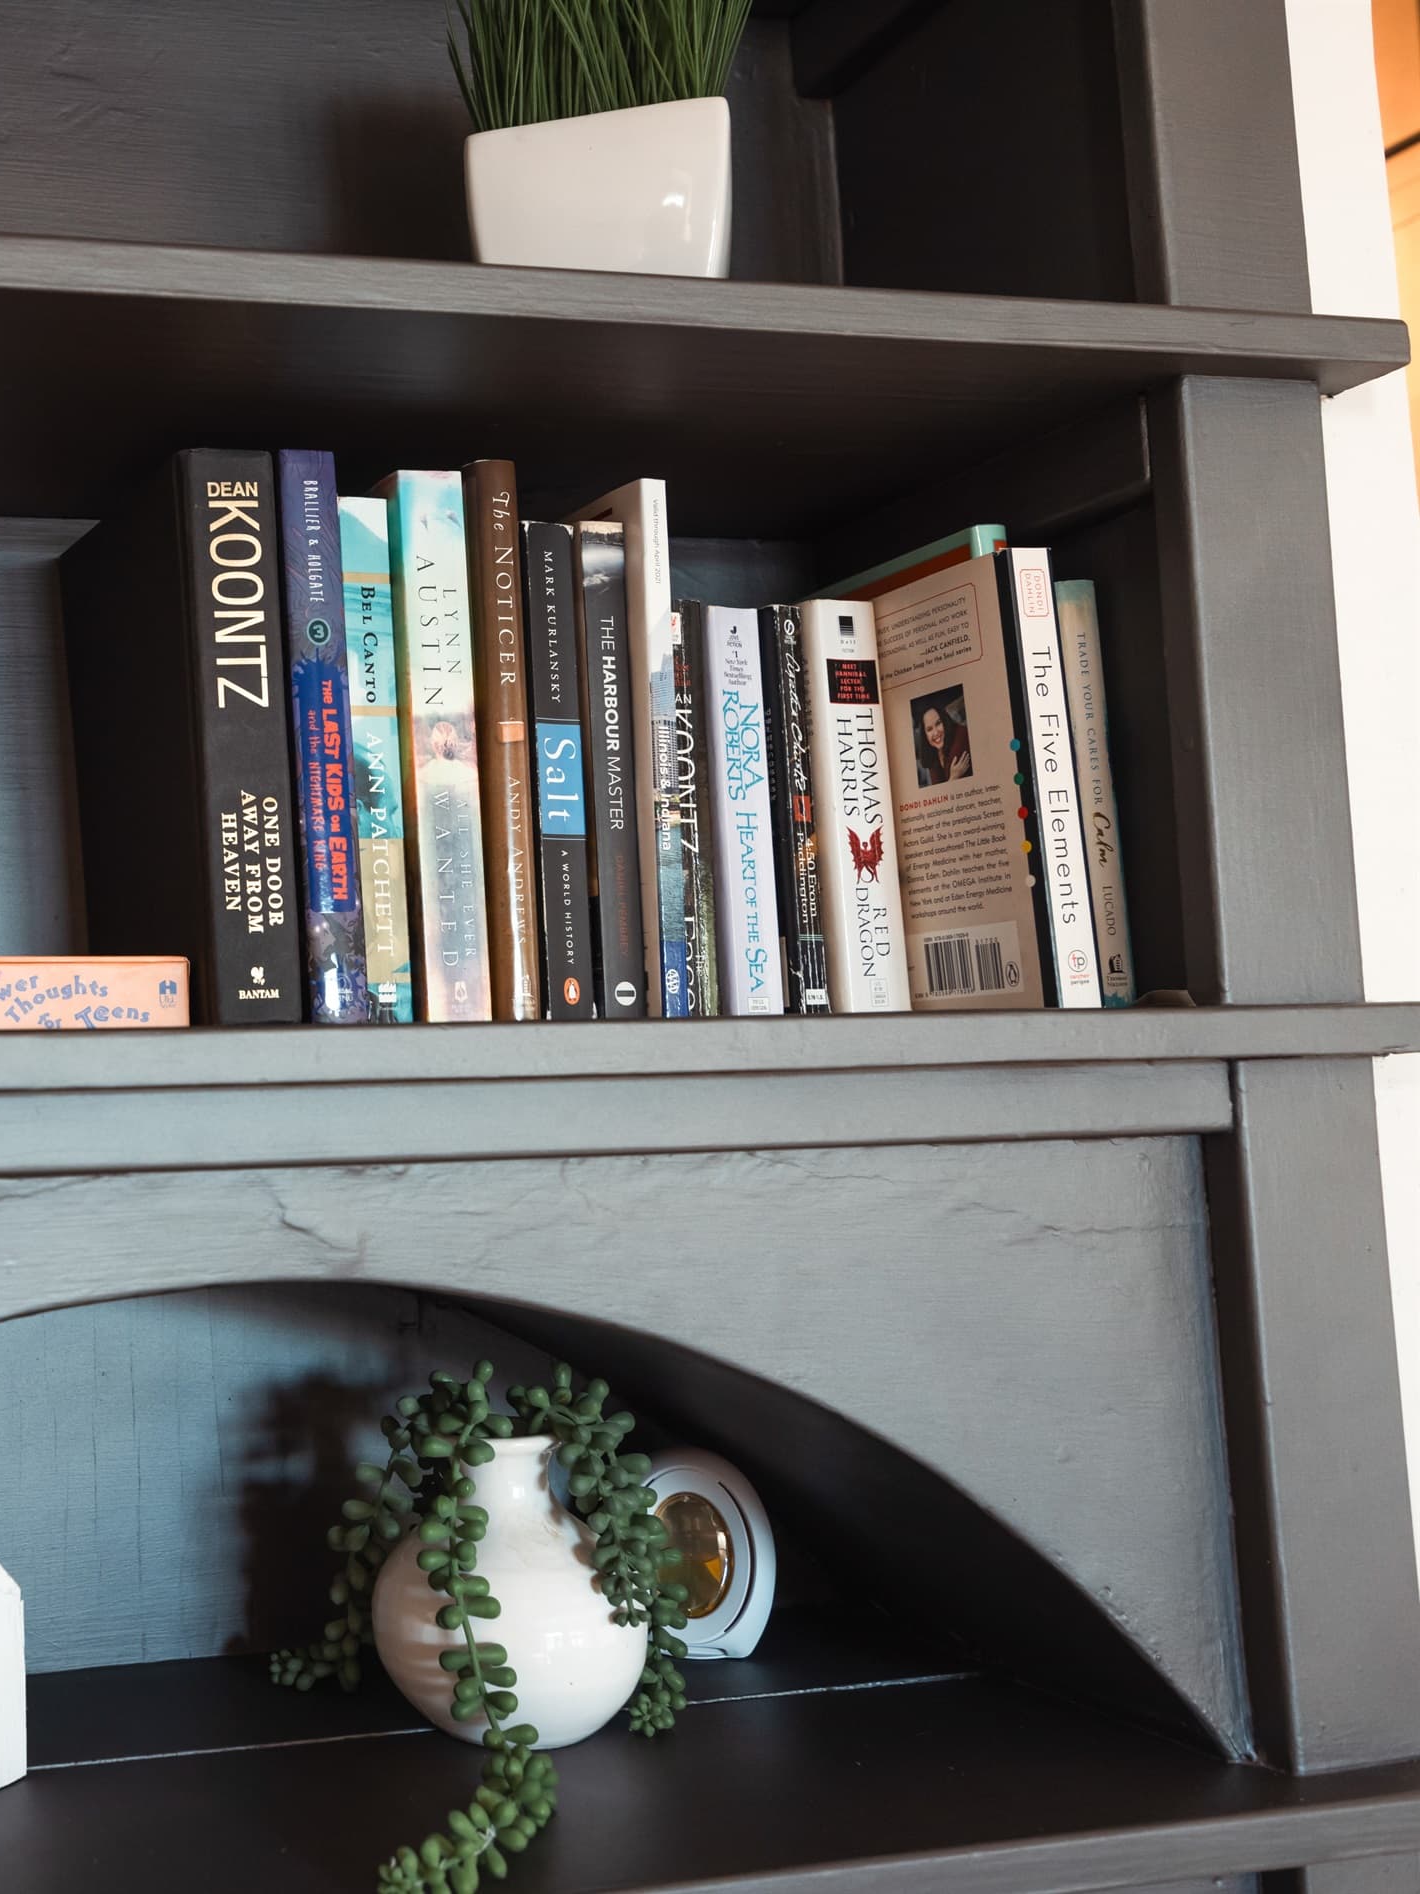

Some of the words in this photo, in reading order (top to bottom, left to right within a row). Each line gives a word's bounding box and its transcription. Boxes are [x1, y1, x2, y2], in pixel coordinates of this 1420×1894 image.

[207, 481, 259, 498] DEAN
[303, 480, 322, 532] BRALLIER
[492, 491, 510, 532] The
[307, 538, 319, 547] &
[652, 549, 661, 567] April
[307, 553, 325, 603] HOLGATE
[543, 550, 556, 597] MARK
[208, 500, 270, 709] KOONTZ
[361, 585, 375, 624] BEL
[416, 555, 444, 706] AUSTIN
[494, 545, 517, 686] NOTICER
[442, 588, 462, 674] LYNN
[547, 604, 561, 704] KURLANSKY
[600, 616, 616, 651] THE
[1076, 632, 1091, 677] TRADE
[362, 632, 379, 704] CANTO
[834, 670, 868, 678] HANNIBAL
[1032, 646, 1053, 698] The
[308, 709, 320, 731] and
[601, 656, 621, 751] HARBOUR
[1081, 683, 1095, 721] YOUR
[309, 735, 321, 754] the
[322, 708, 340, 759] LAST
[658, 725, 672, 775] Illinois
[722, 689, 747, 801] ROBERTS
[738, 703, 765, 792] NORA
[1039, 713, 1059, 774] Five
[1086, 727, 1100, 771] CARES
[325, 762, 345, 812] KIDS
[365, 733, 386, 794] ANN
[543, 736, 579, 822] Salt
[660, 779, 671, 790] &
[836, 718, 860, 817] HARRIS
[855, 708, 883, 825] THOMAS
[309, 761, 325, 833] NIGHTMARE
[456, 800, 470, 835] ALL
[507, 775, 522, 834] ANDY
[607, 756, 625, 831] MASTER
[1091, 779, 1104, 805] FOR
[240, 789, 260, 855] AWAY
[262, 796, 280, 847] ONE
[661, 794, 672, 851] Indiana
[736, 811, 759, 884] HEART
[1091, 811, 1115, 869] Calm
[221, 812, 242, 912] HEAVEN
[313, 839, 327, 871] KING
[328, 836, 349, 901] EARTH
[433, 790, 459, 967] WANTED
[459, 850, 475, 888] SHE
[796, 831, 810, 924] Paddington
[805, 837, 817, 871] 4:50
[1048, 789, 1079, 925] Elements
[246, 863, 265, 934] FROM
[265, 857, 285, 926] DOOR
[370, 807, 395, 957] PATCHETT
[510, 845, 527, 945] ANDREWS
[562, 863, 571, 907] WORLD
[744, 883, 758, 908] OF
[806, 874, 818, 917] From
[462, 904, 477, 957] EVER
[745, 912, 760, 943] THE
[855, 887, 877, 978] DRAGON
[872, 907, 891, 958] RED
[1102, 885, 1118, 936] LUCADO
[565, 912, 575, 965] HISTORY
[238, 988, 280, 1000] BANTAM
[745, 948, 768, 993] SEA
[5, 974, 109, 1023] Thoughts
[74, 1004, 151, 1030] Teens
